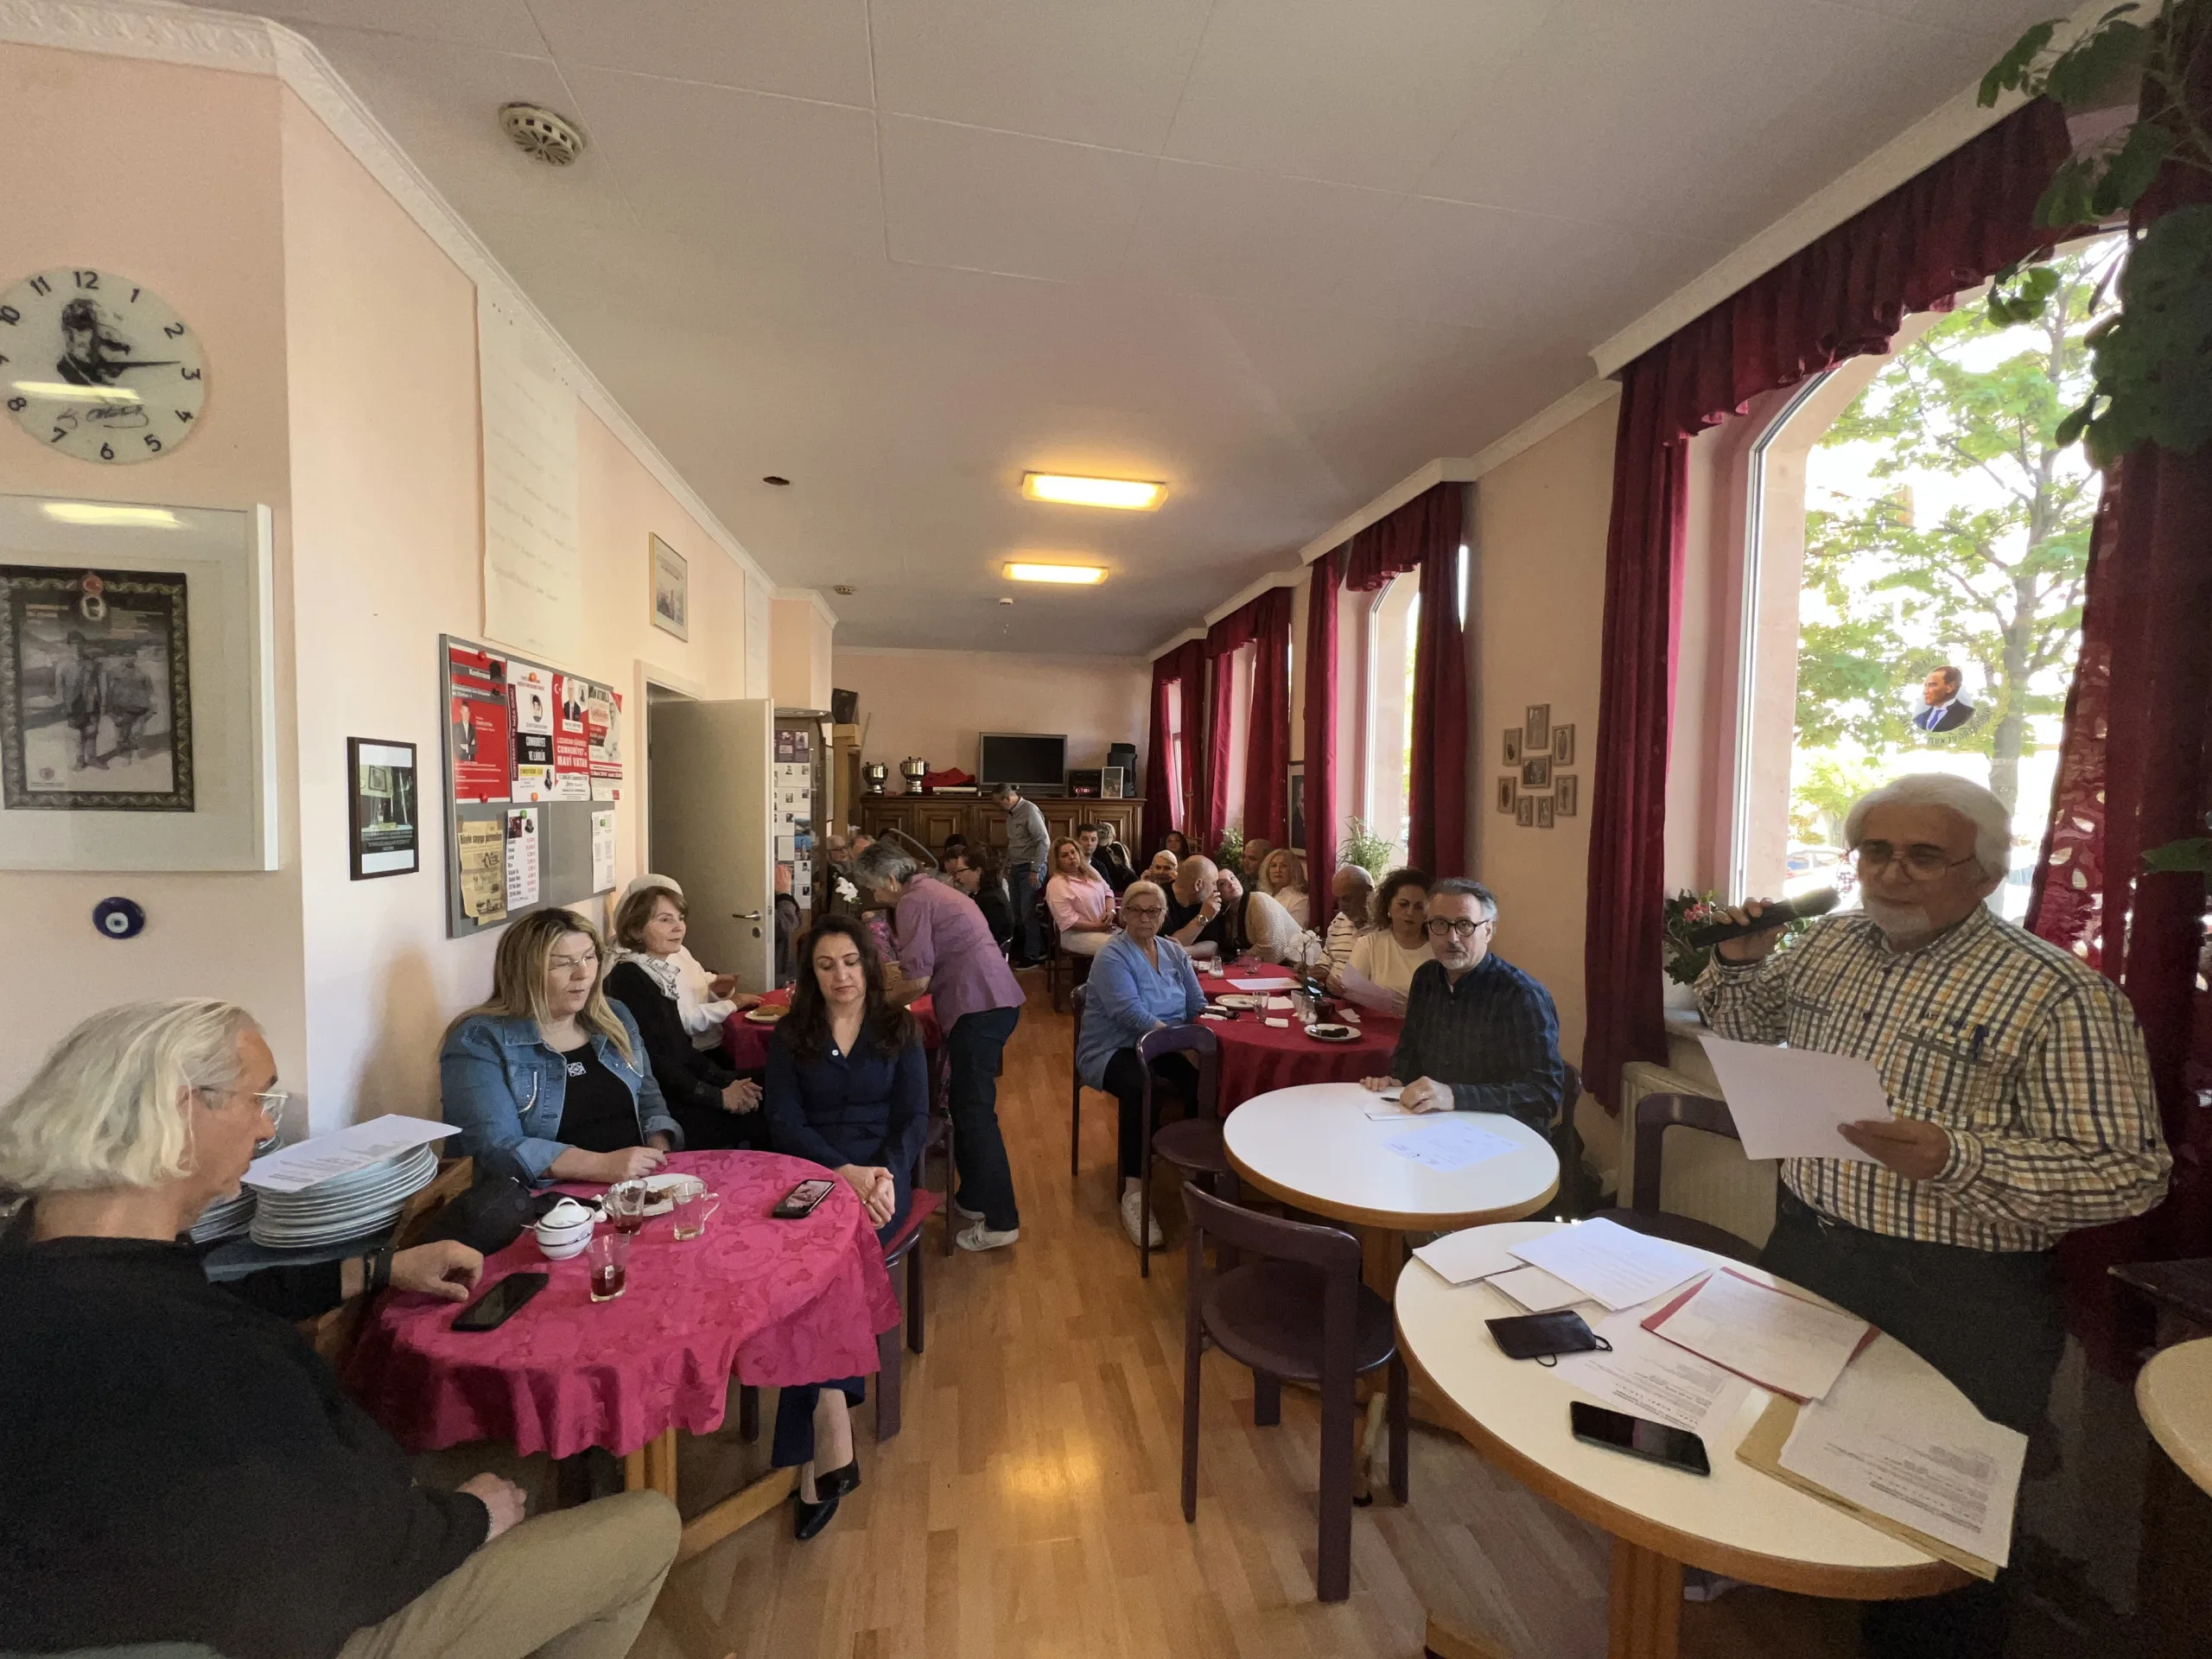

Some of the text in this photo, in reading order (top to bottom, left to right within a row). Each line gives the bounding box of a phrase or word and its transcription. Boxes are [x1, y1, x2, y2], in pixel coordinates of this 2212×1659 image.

[29, 275, 52, 296] 11
[73, 270, 99, 289] 12
[130, 287, 141, 303] 1
[162, 321, 185, 339] 2
[180, 366, 201, 381] 3
[7, 396, 27, 412] 8
[174, 408, 194, 423] 4
[50, 426, 67, 443] 7
[143, 433, 162, 453] 5
[99, 442, 115, 461] 6
[557, 755, 572, 766] MAVİ
